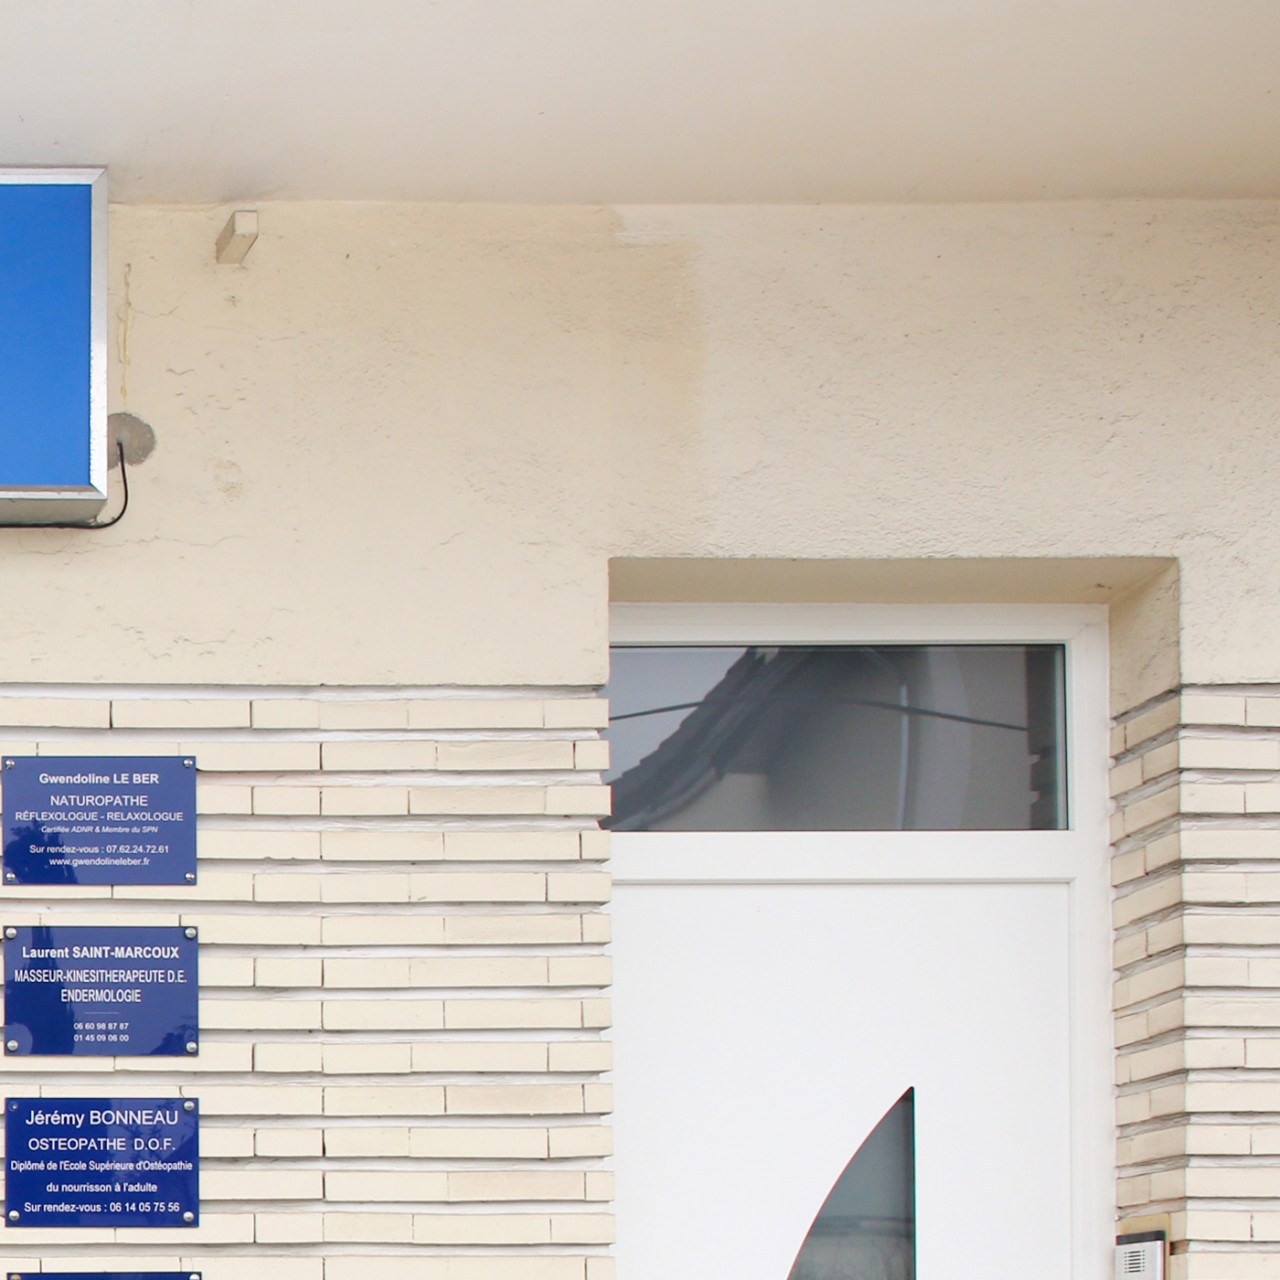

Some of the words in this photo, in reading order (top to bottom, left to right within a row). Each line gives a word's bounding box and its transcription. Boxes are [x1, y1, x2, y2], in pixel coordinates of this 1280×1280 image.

[38, 772, 111, 785] Gwendoline
[112, 772, 130, 785] LE
[132, 772, 160, 785] BER
[50, 794, 149, 807] NATUROPATHE
[14, 810, 99, 822] RÉFLEXOLOGUE
[106, 810, 184, 822] RELAXOLOGUE
[40, 825, 71, 834] Certifiée
[70, 825, 94, 834] ADNR
[94, 825, 101, 834] &
[100, 825, 131, 834] Membre
[130, 825, 141, 834] du
[141, 825, 159, 834] SPN
[29, 844, 45, 854] Sur
[46, 844, 100, 854] rendez-vous
[105, 844, 169, 854] 07.62.24.72.61
[48, 856, 151, 867] www.gwendolineleber.fr
[22, 945, 70, 959] Laurent
[71, 945, 180, 959] SAINT-MARCOUX
[14, 969, 166, 983] MASSEUR-KINESITHERAPEUTE
[167, 969, 188, 983] D.E.
[60, 988, 142, 1003] ENDERMOLOGIE
[24, 1109, 86, 1127] Jérémy
[89, 1109, 179, 1126] BONNEAU
[27, 1137, 127, 1151] OSTEOPATHE
[133, 1137, 176, 1151] D.O.F.
[10, 1159, 46, 1173] Diplômé
[46, 1159, 59, 1171] de
[58, 1159, 88, 1171] l'Ecole
[88, 1159, 135, 1173] Supérieure
[135, 1159, 194, 1173] d'Ostéopathie
[45, 1181, 60, 1193] du
[60, 1181, 113, 1193] nourrisson
[113, 1181, 122, 1193] à
[122, 1181, 159, 1193] l'adulte
[23, 1201, 43, 1213] Sur
[43, 1201, 103, 1213] rendez-vous
[109, 1201, 123, 1213] 06
[124, 1201, 137, 1213] 14
[138, 1201, 152, 1213] 05
[152, 1201, 167, 1213] 75
[167, 1201, 181, 1213] 56
